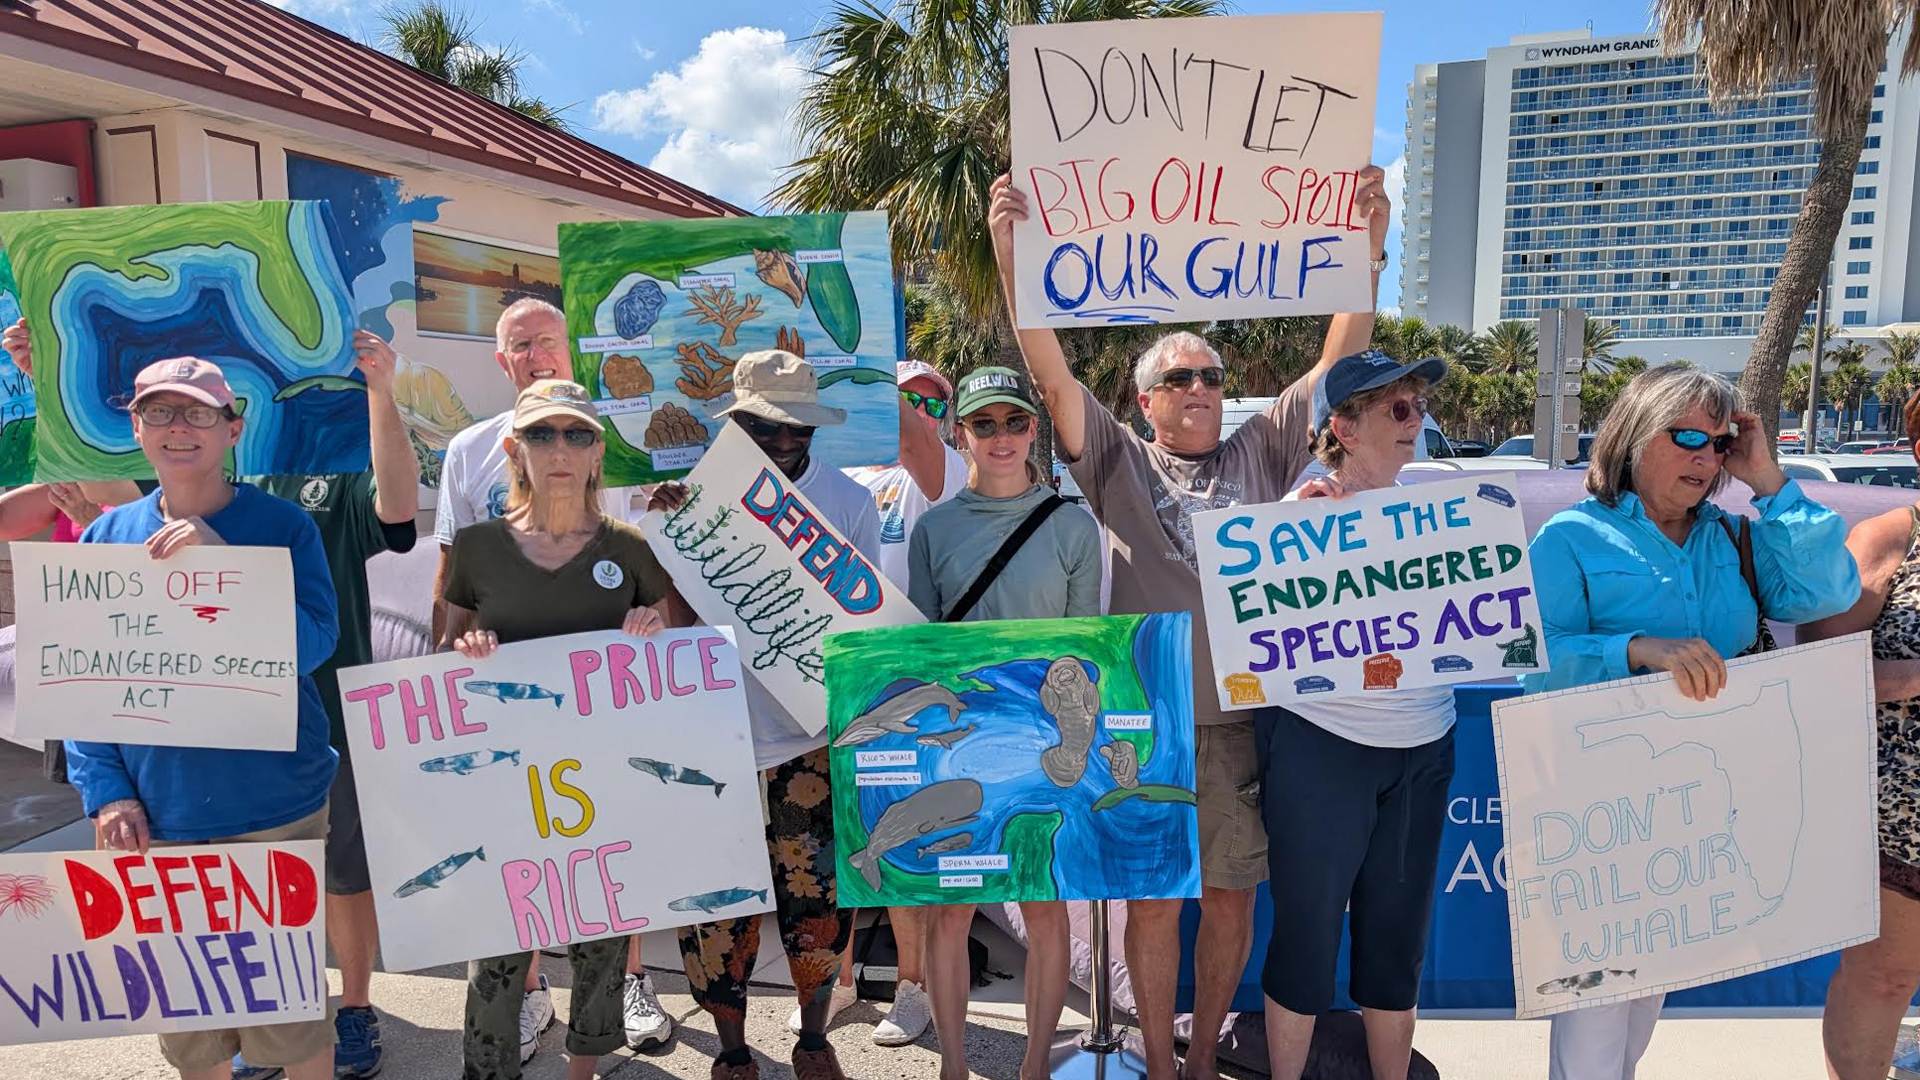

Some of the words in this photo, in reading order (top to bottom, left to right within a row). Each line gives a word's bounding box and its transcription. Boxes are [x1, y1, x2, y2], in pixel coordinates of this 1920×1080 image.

[1542, 42, 1610, 58] WYNDHAM
[1035, 47, 1250, 142] DON'T
[1243, 69, 1358, 159] LET
[1030, 157, 1136, 237] BIG
[1151, 157, 1241, 226] OIL
[1261, 165, 1368, 232] SPOIL
[1043, 232, 1180, 311] OUR
[1185, 235, 1344, 301] GULF
[969, 373, 1018, 394] REELWILD
[740, 466, 884, 616] DEFEND
[1216, 510, 1367, 577] SAVE
[1382, 497, 1470, 541] THE
[42, 564, 144, 603] HANDS
[166, 569, 244, 600] OFF
[1228, 543, 1523, 624] ENDANGERED
[40, 643, 203, 678] ENDANGERED
[213, 654, 297, 679] SPECIES
[108, 613, 164, 638] THE
[1249, 611, 1420, 673] SPECIES
[1434, 587, 1532, 645] ACT
[122, 686, 176, 709] ACT
[345, 667, 488, 750] THE
[569, 637, 736, 717] PRICE
[1107, 717, 1148, 726] MANATEE
[889, 752, 913, 762] WHALE
[527, 758, 596, 839] IS
[1533, 780, 1702, 866] DON'T
[64, 848, 318, 941] DEFEND
[501, 840, 649, 951] RICE
[942, 859, 971, 868] SPERM
[975, 858, 1003, 867] WHALE
[1518, 863, 1641, 919] FAIL
[1645, 832, 1737, 896] OUR
[1562, 891, 1738, 965] WHALE
